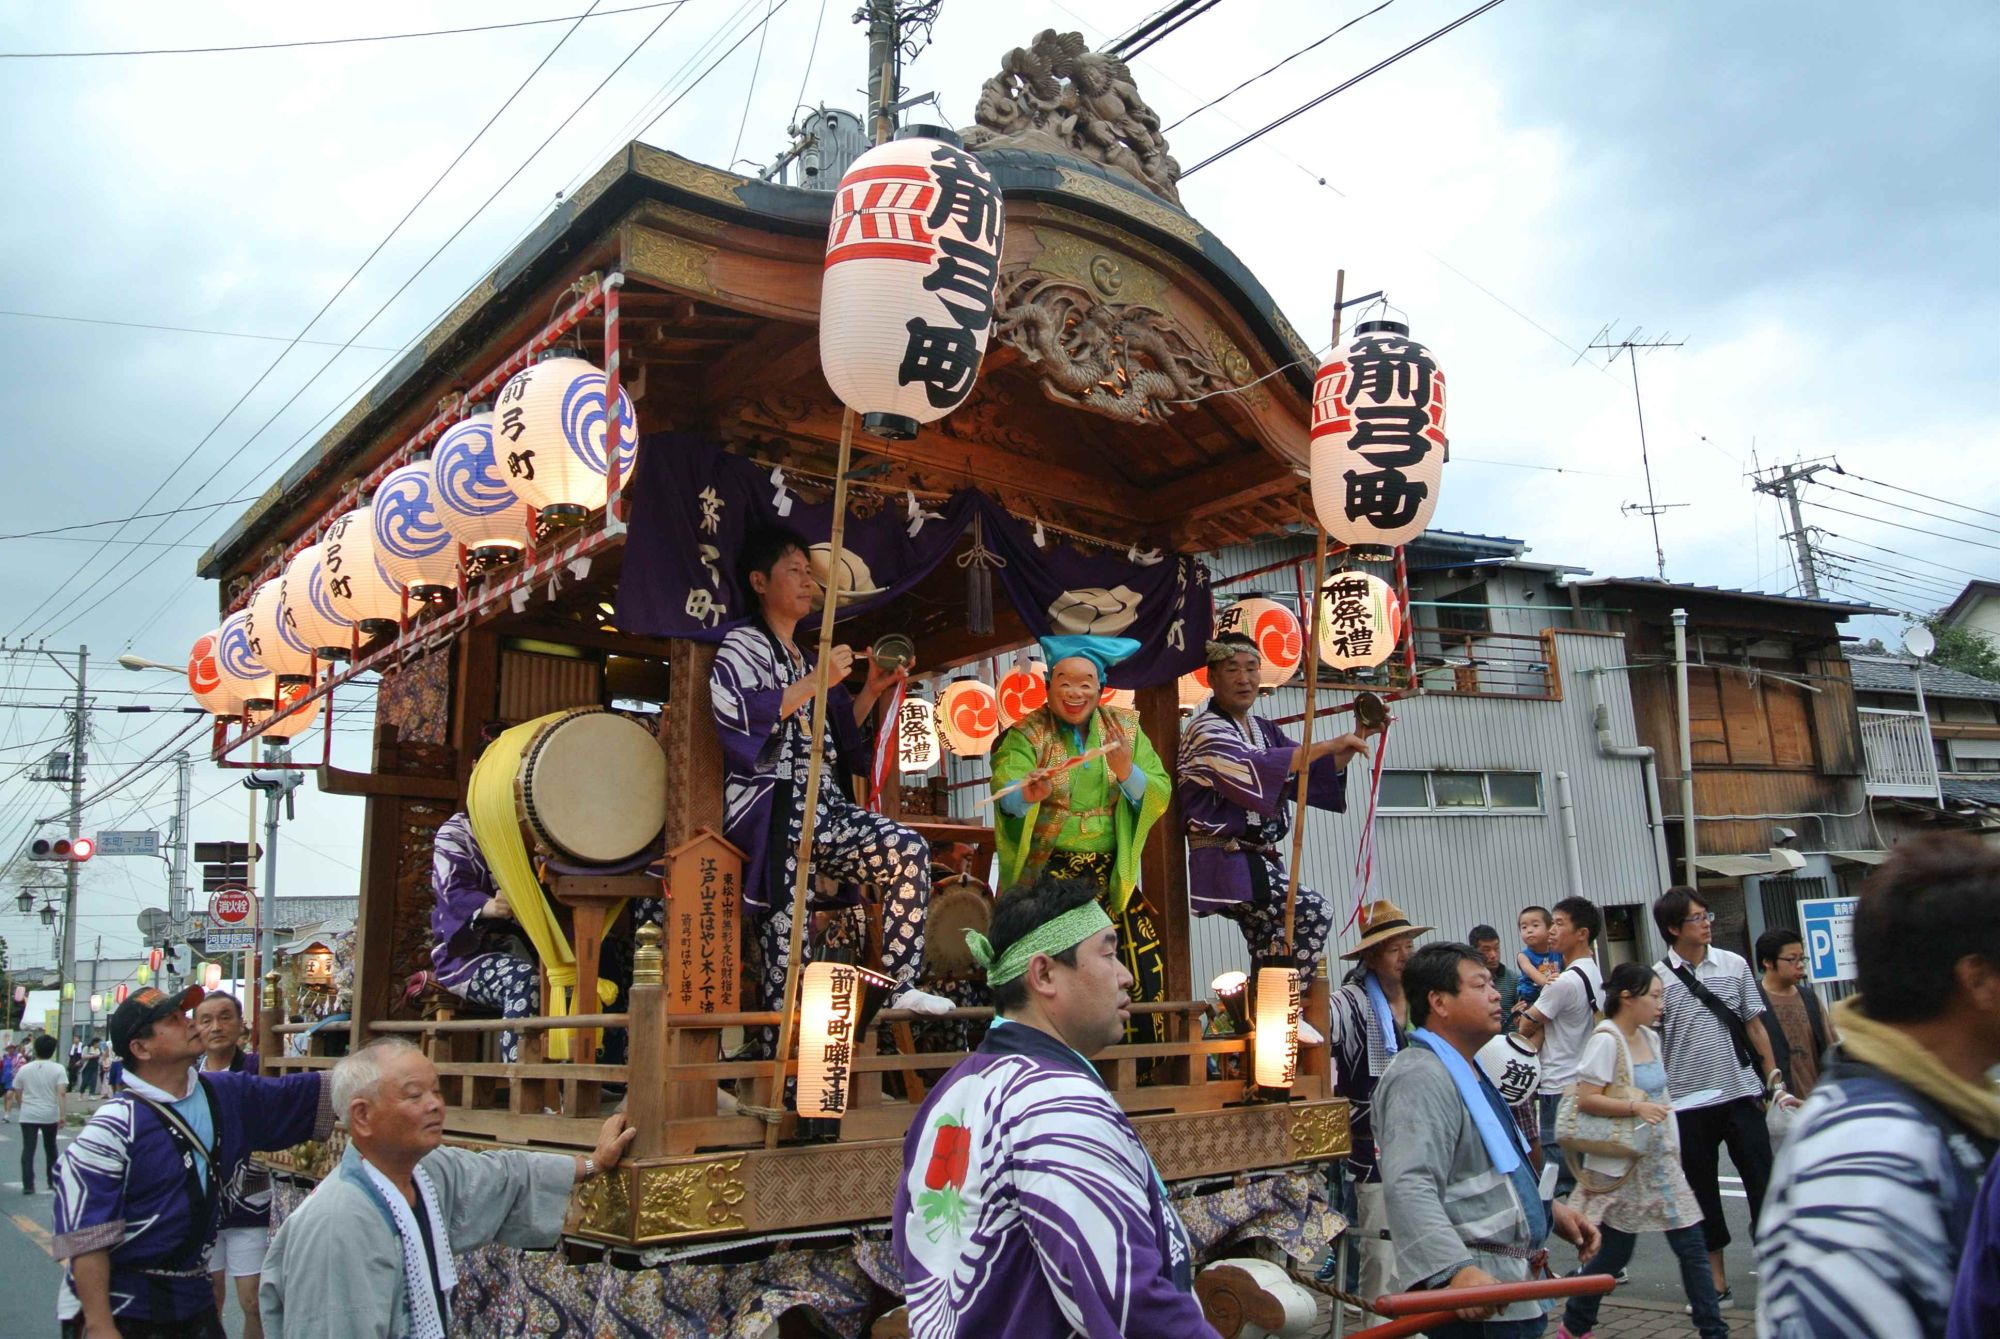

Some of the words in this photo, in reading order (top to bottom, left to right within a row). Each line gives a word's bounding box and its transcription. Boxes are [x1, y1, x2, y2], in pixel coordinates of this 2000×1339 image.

[1343, 336, 1436, 529] 箭弓町
[101, 836, 154, 848] 本町一丁目
[218, 900, 249, 913] 消火栓
[1811, 929, 1831, 970] P
